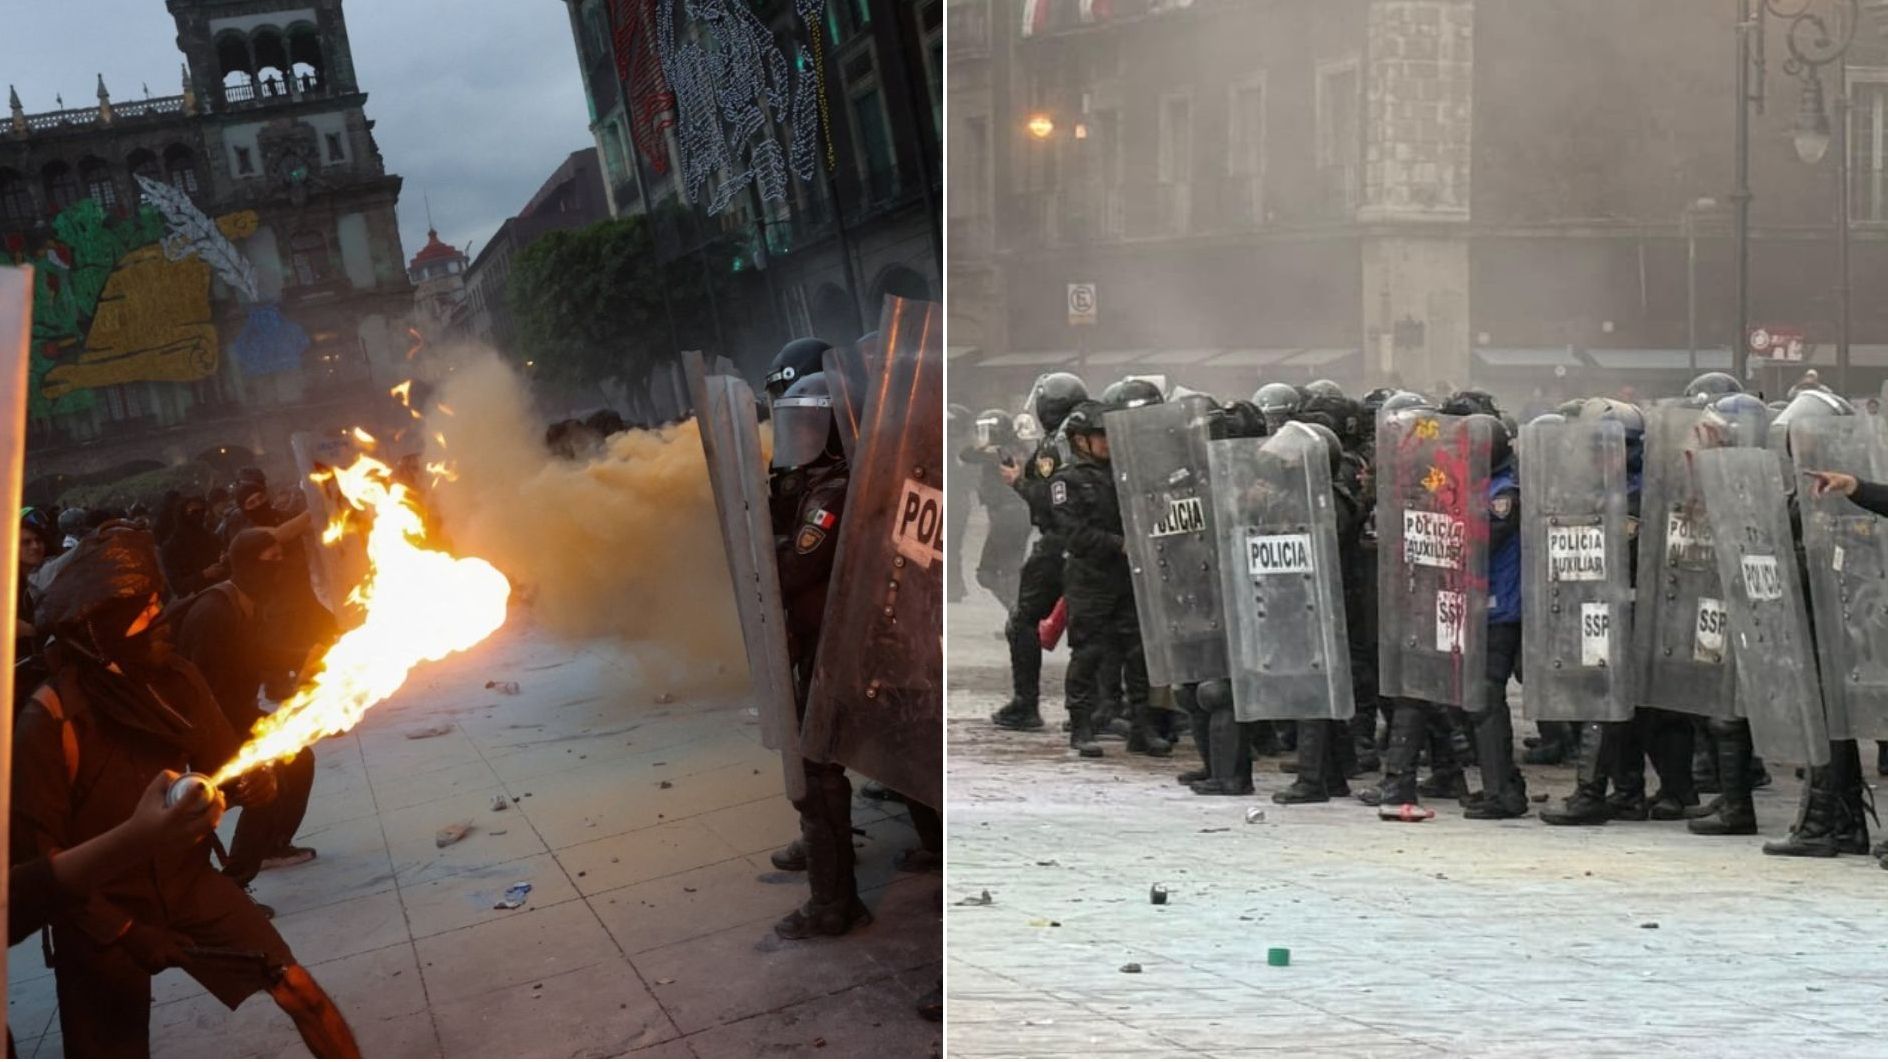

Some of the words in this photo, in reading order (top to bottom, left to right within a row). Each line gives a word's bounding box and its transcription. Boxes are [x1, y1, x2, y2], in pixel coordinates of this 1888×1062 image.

[1550, 534, 1603, 551] POLICIA
[1250, 543, 1308, 569] POLICIA
[1551, 555, 1605, 574] AUXILIAR
[1584, 614, 1610, 637] SSP
[1698, 608, 1728, 634] SSP
